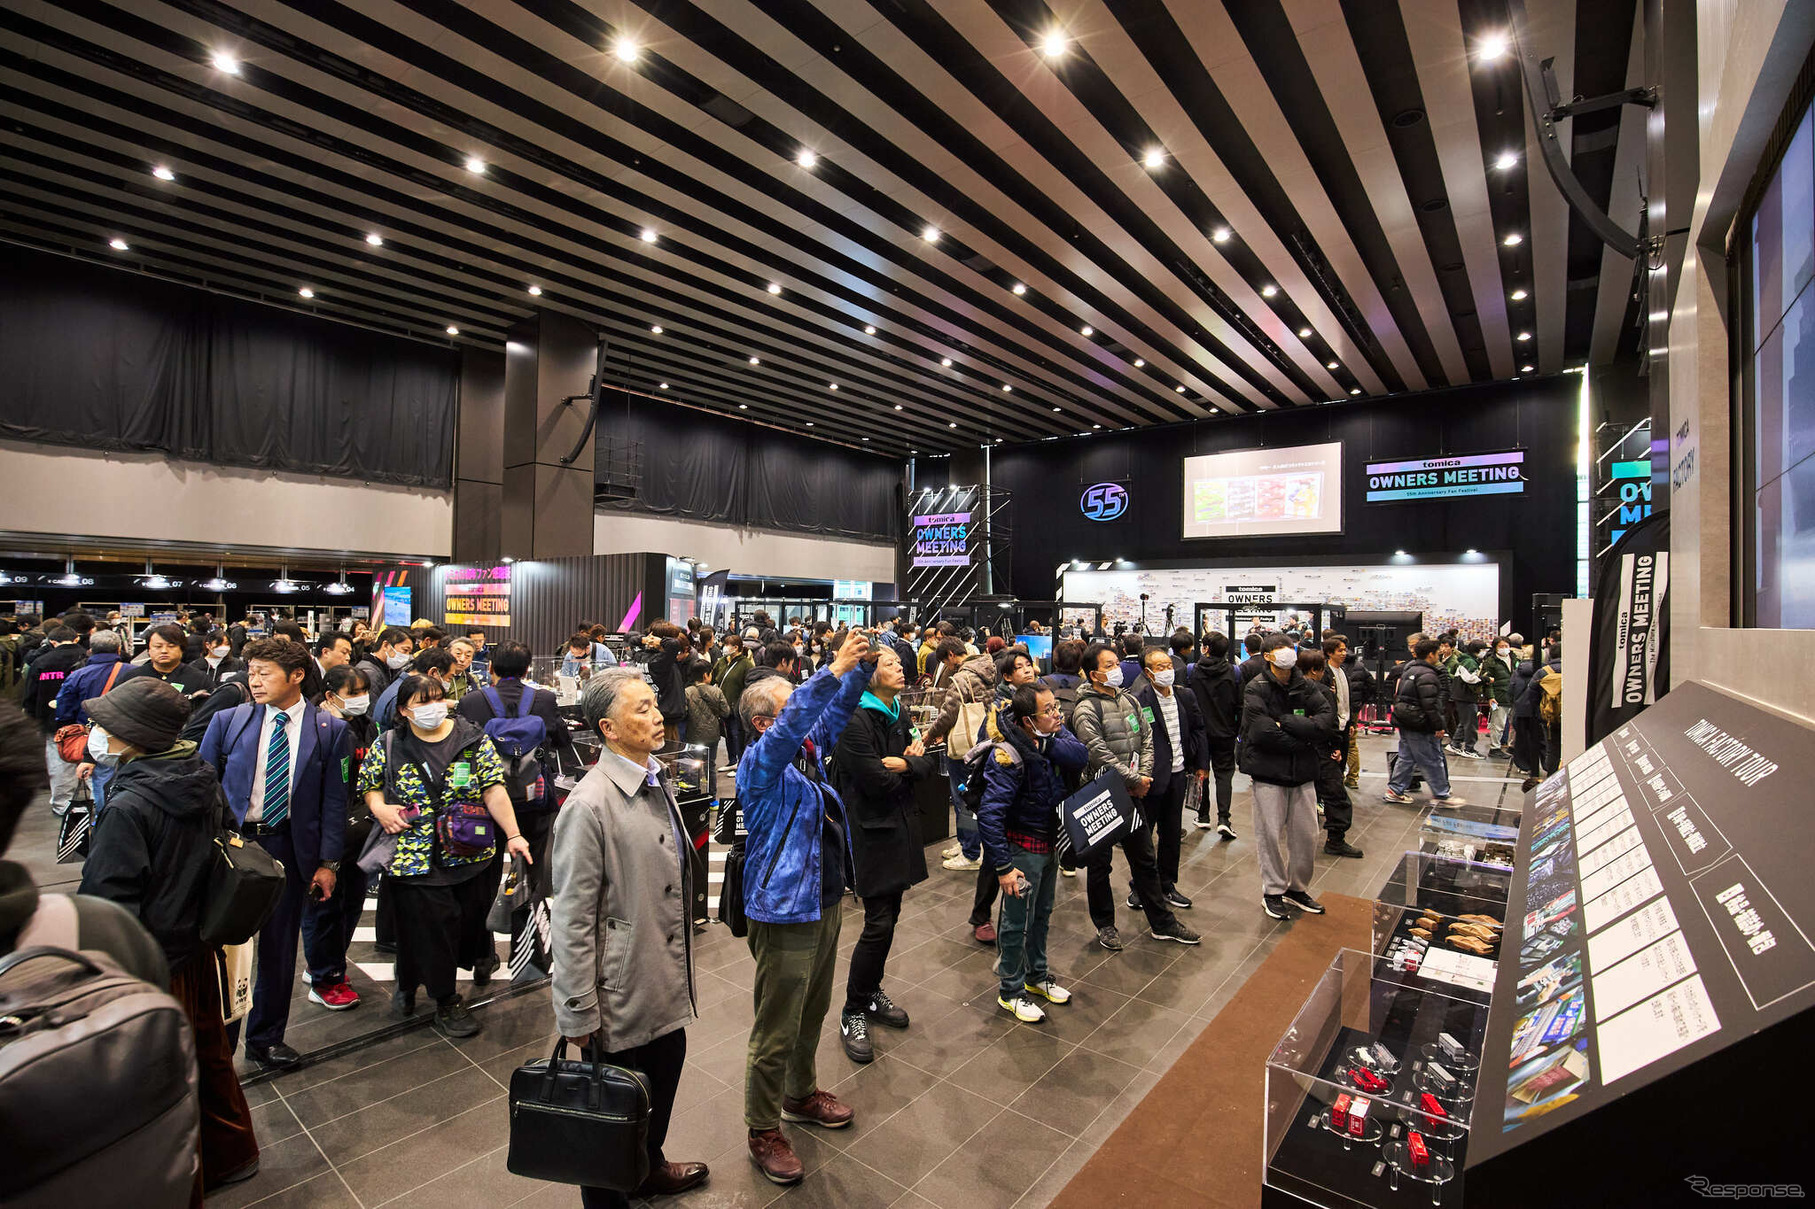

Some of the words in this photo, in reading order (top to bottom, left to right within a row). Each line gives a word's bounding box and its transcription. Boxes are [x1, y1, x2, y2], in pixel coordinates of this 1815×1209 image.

[1422, 459, 1461, 468] tomica
[1369, 472, 1438, 490] OWNERS
[1444, 466, 1520, 484] MEETING
[916, 526, 967, 541] OWNERS
[916, 540, 967, 554] MEETING
[1228, 595, 1273, 603] OWNERS
[1632, 555, 1653, 627] MEETING
[446, 598, 475, 611] OWNERS
[476, 598, 509, 612] MEETING
[1618, 612, 1628, 650] tomica
[1625, 632, 1647, 704] OWNERS
[1684, 718, 1718, 749] TOMICA
[1705, 732, 1753, 768] FACTORY
[1730, 752, 1779, 787] TOUR
[1080, 799, 1114, 827] OWNERS
[1084, 808, 1118, 836] MEETING
